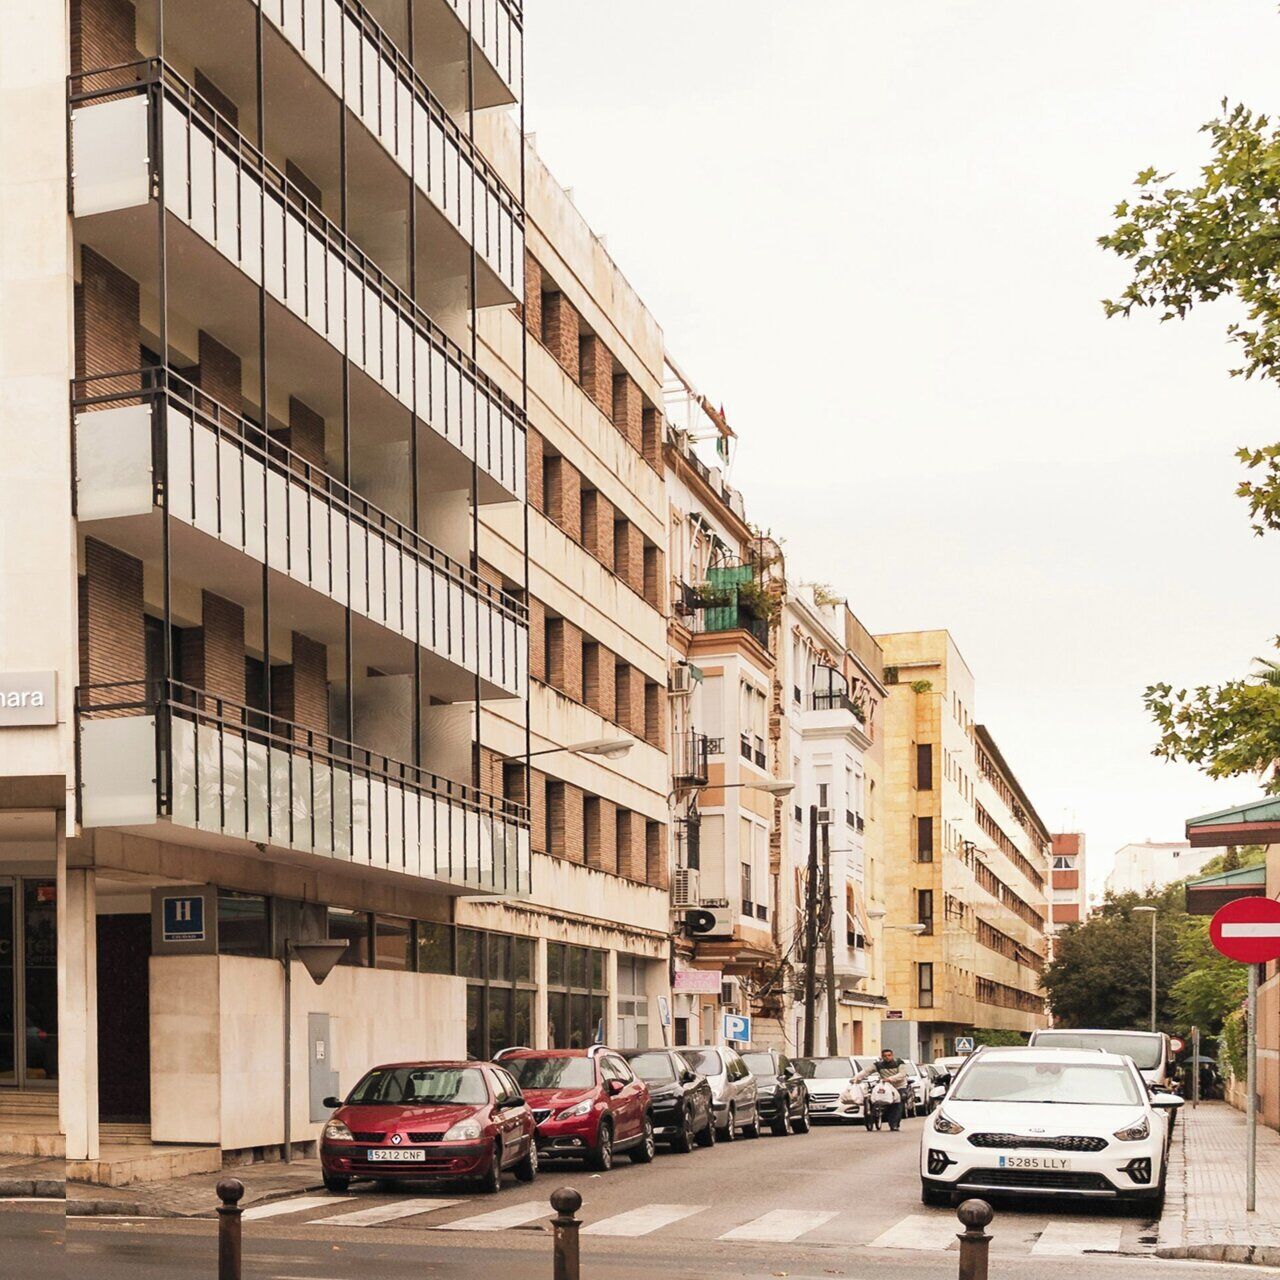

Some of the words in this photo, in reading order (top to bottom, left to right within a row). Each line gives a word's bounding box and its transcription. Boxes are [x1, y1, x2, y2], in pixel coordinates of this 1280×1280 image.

[175, 900, 191, 921] H
[725, 1016, 745, 1039] P
[374, 1151, 400, 1159] 5212
[403, 1151, 422, 1159] CNF
[1008, 1157, 1039, 1168] 5285
[1043, 1158, 1067, 1169] LLY
